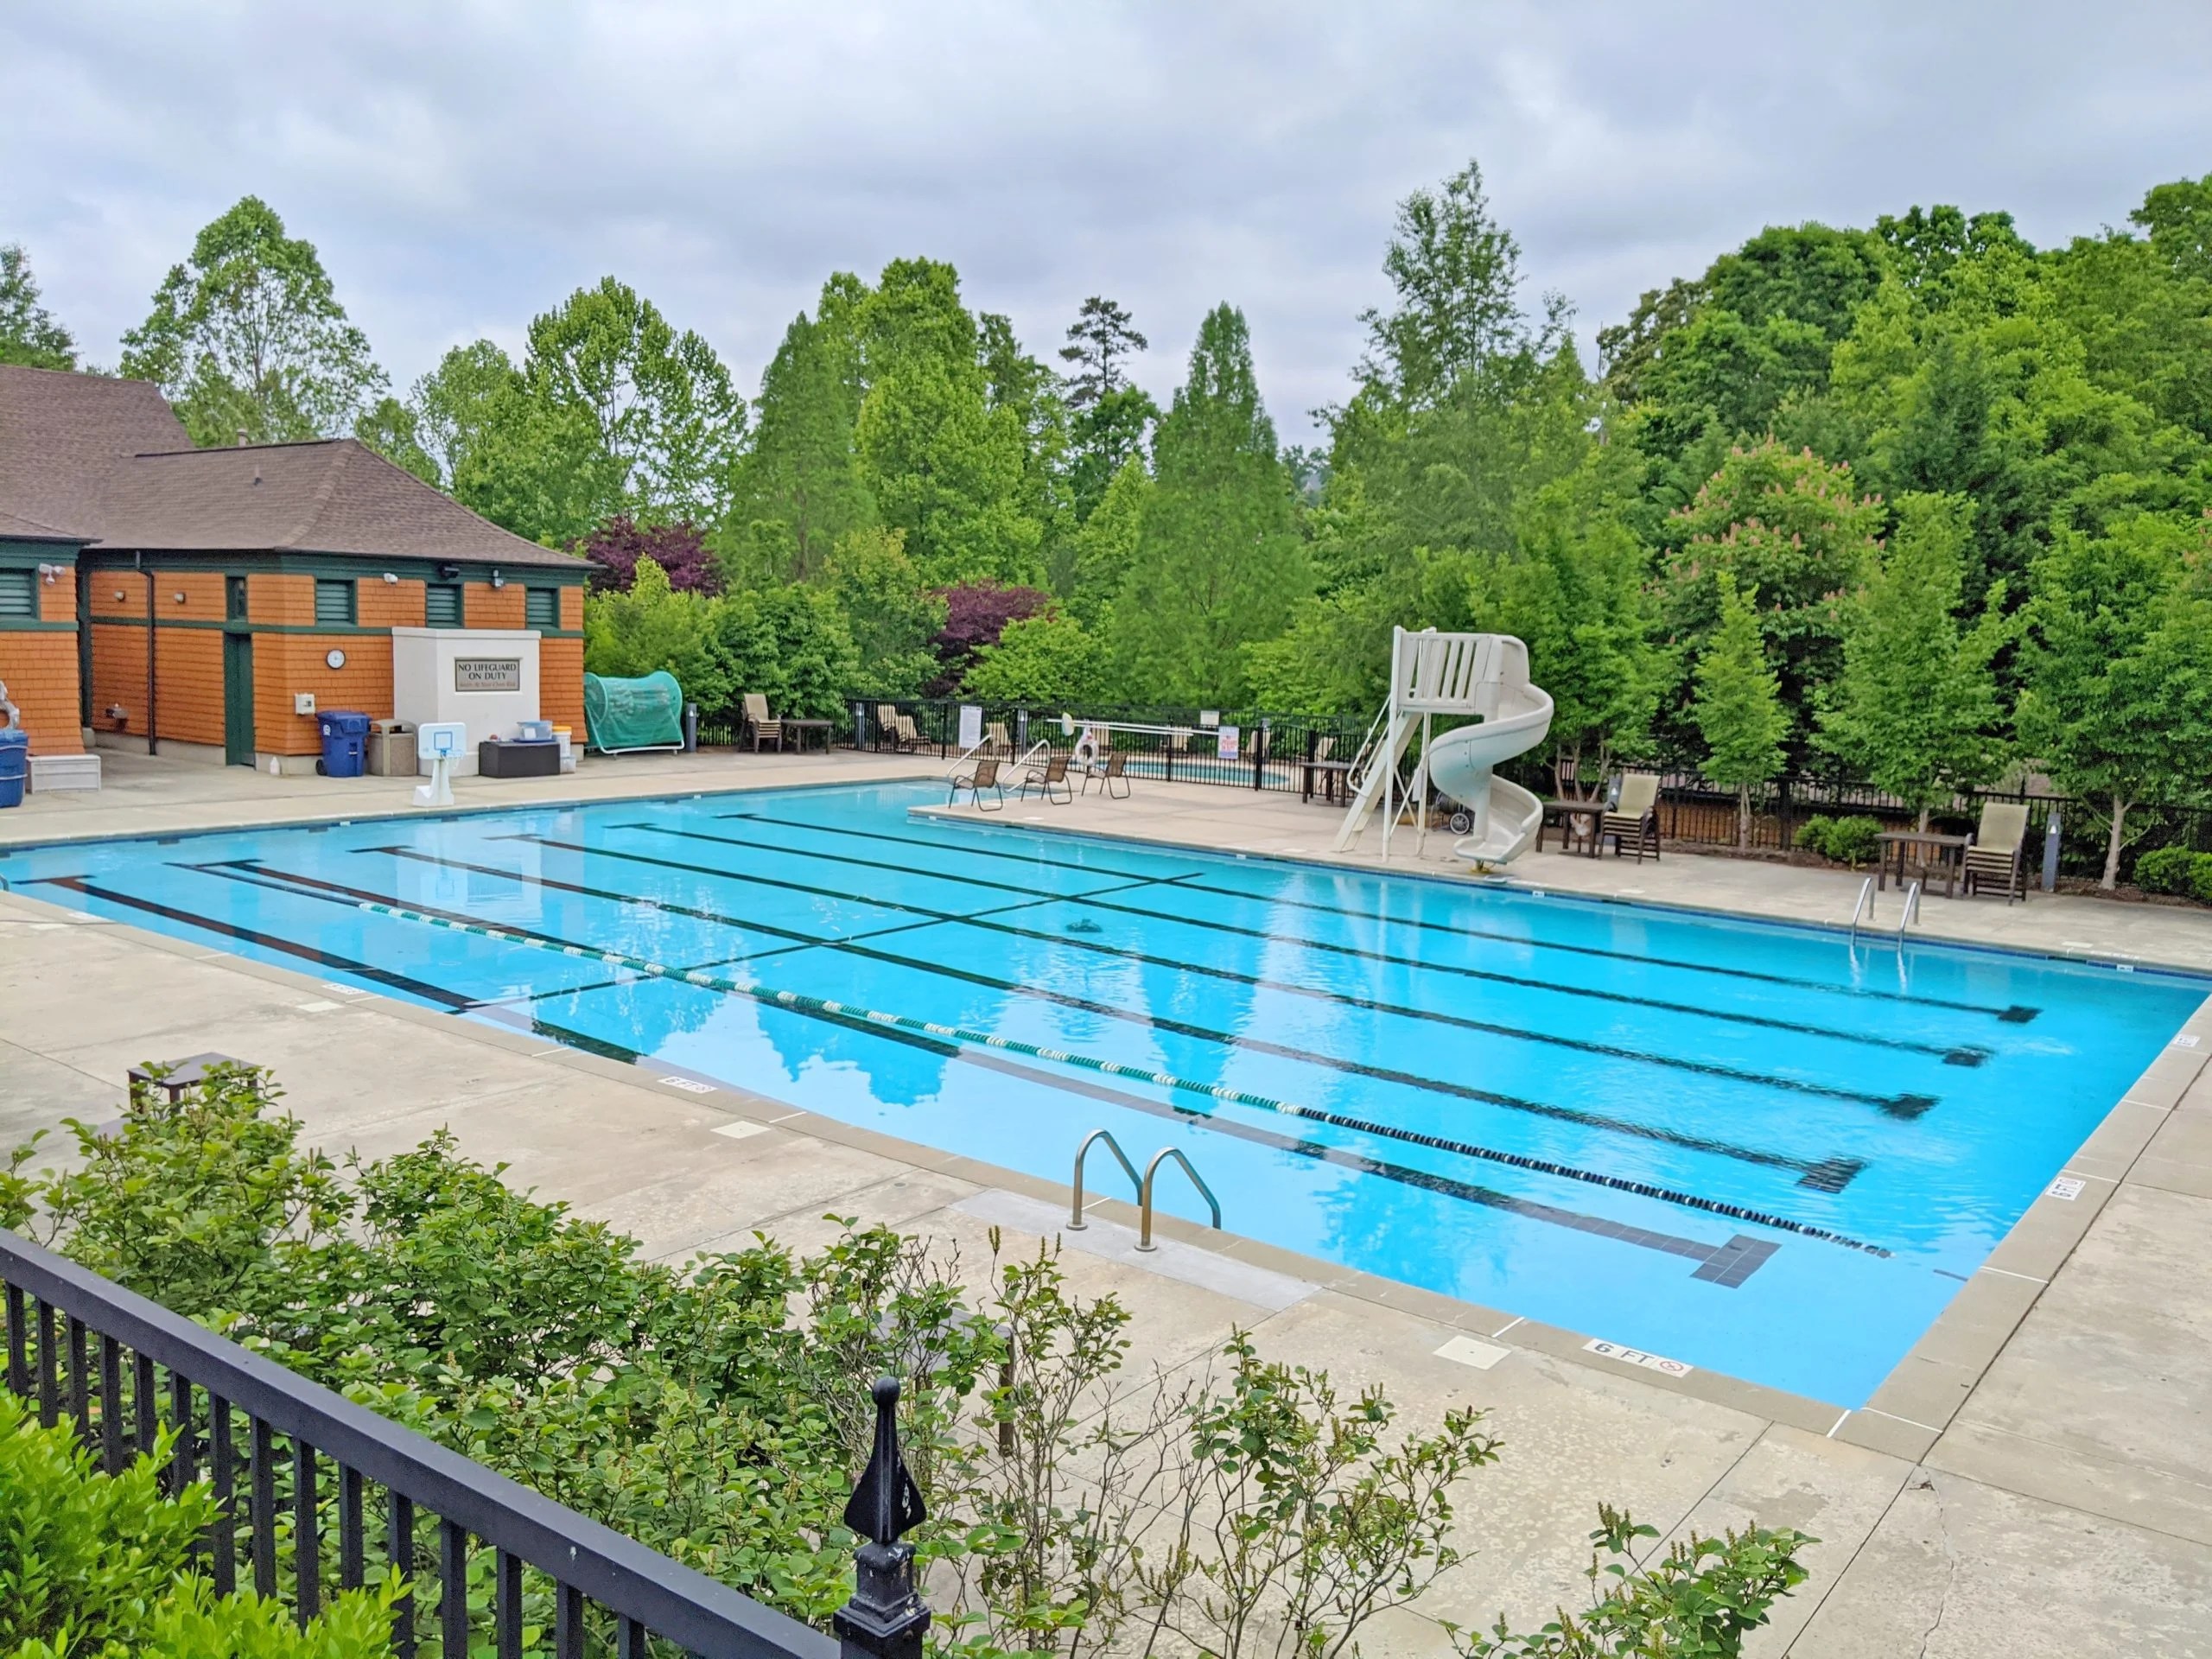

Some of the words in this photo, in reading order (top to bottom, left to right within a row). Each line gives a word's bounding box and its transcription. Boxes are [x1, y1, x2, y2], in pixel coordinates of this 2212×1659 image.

[458, 663, 472, 671] NO
[474, 663, 517, 671] LIFEGUARD
[468, 671, 481, 680] ON
[485, 671, 505, 680] DUTY
[1595, 1343, 1614, 1353] 6
[1620, 1350, 1655, 1363] FT
